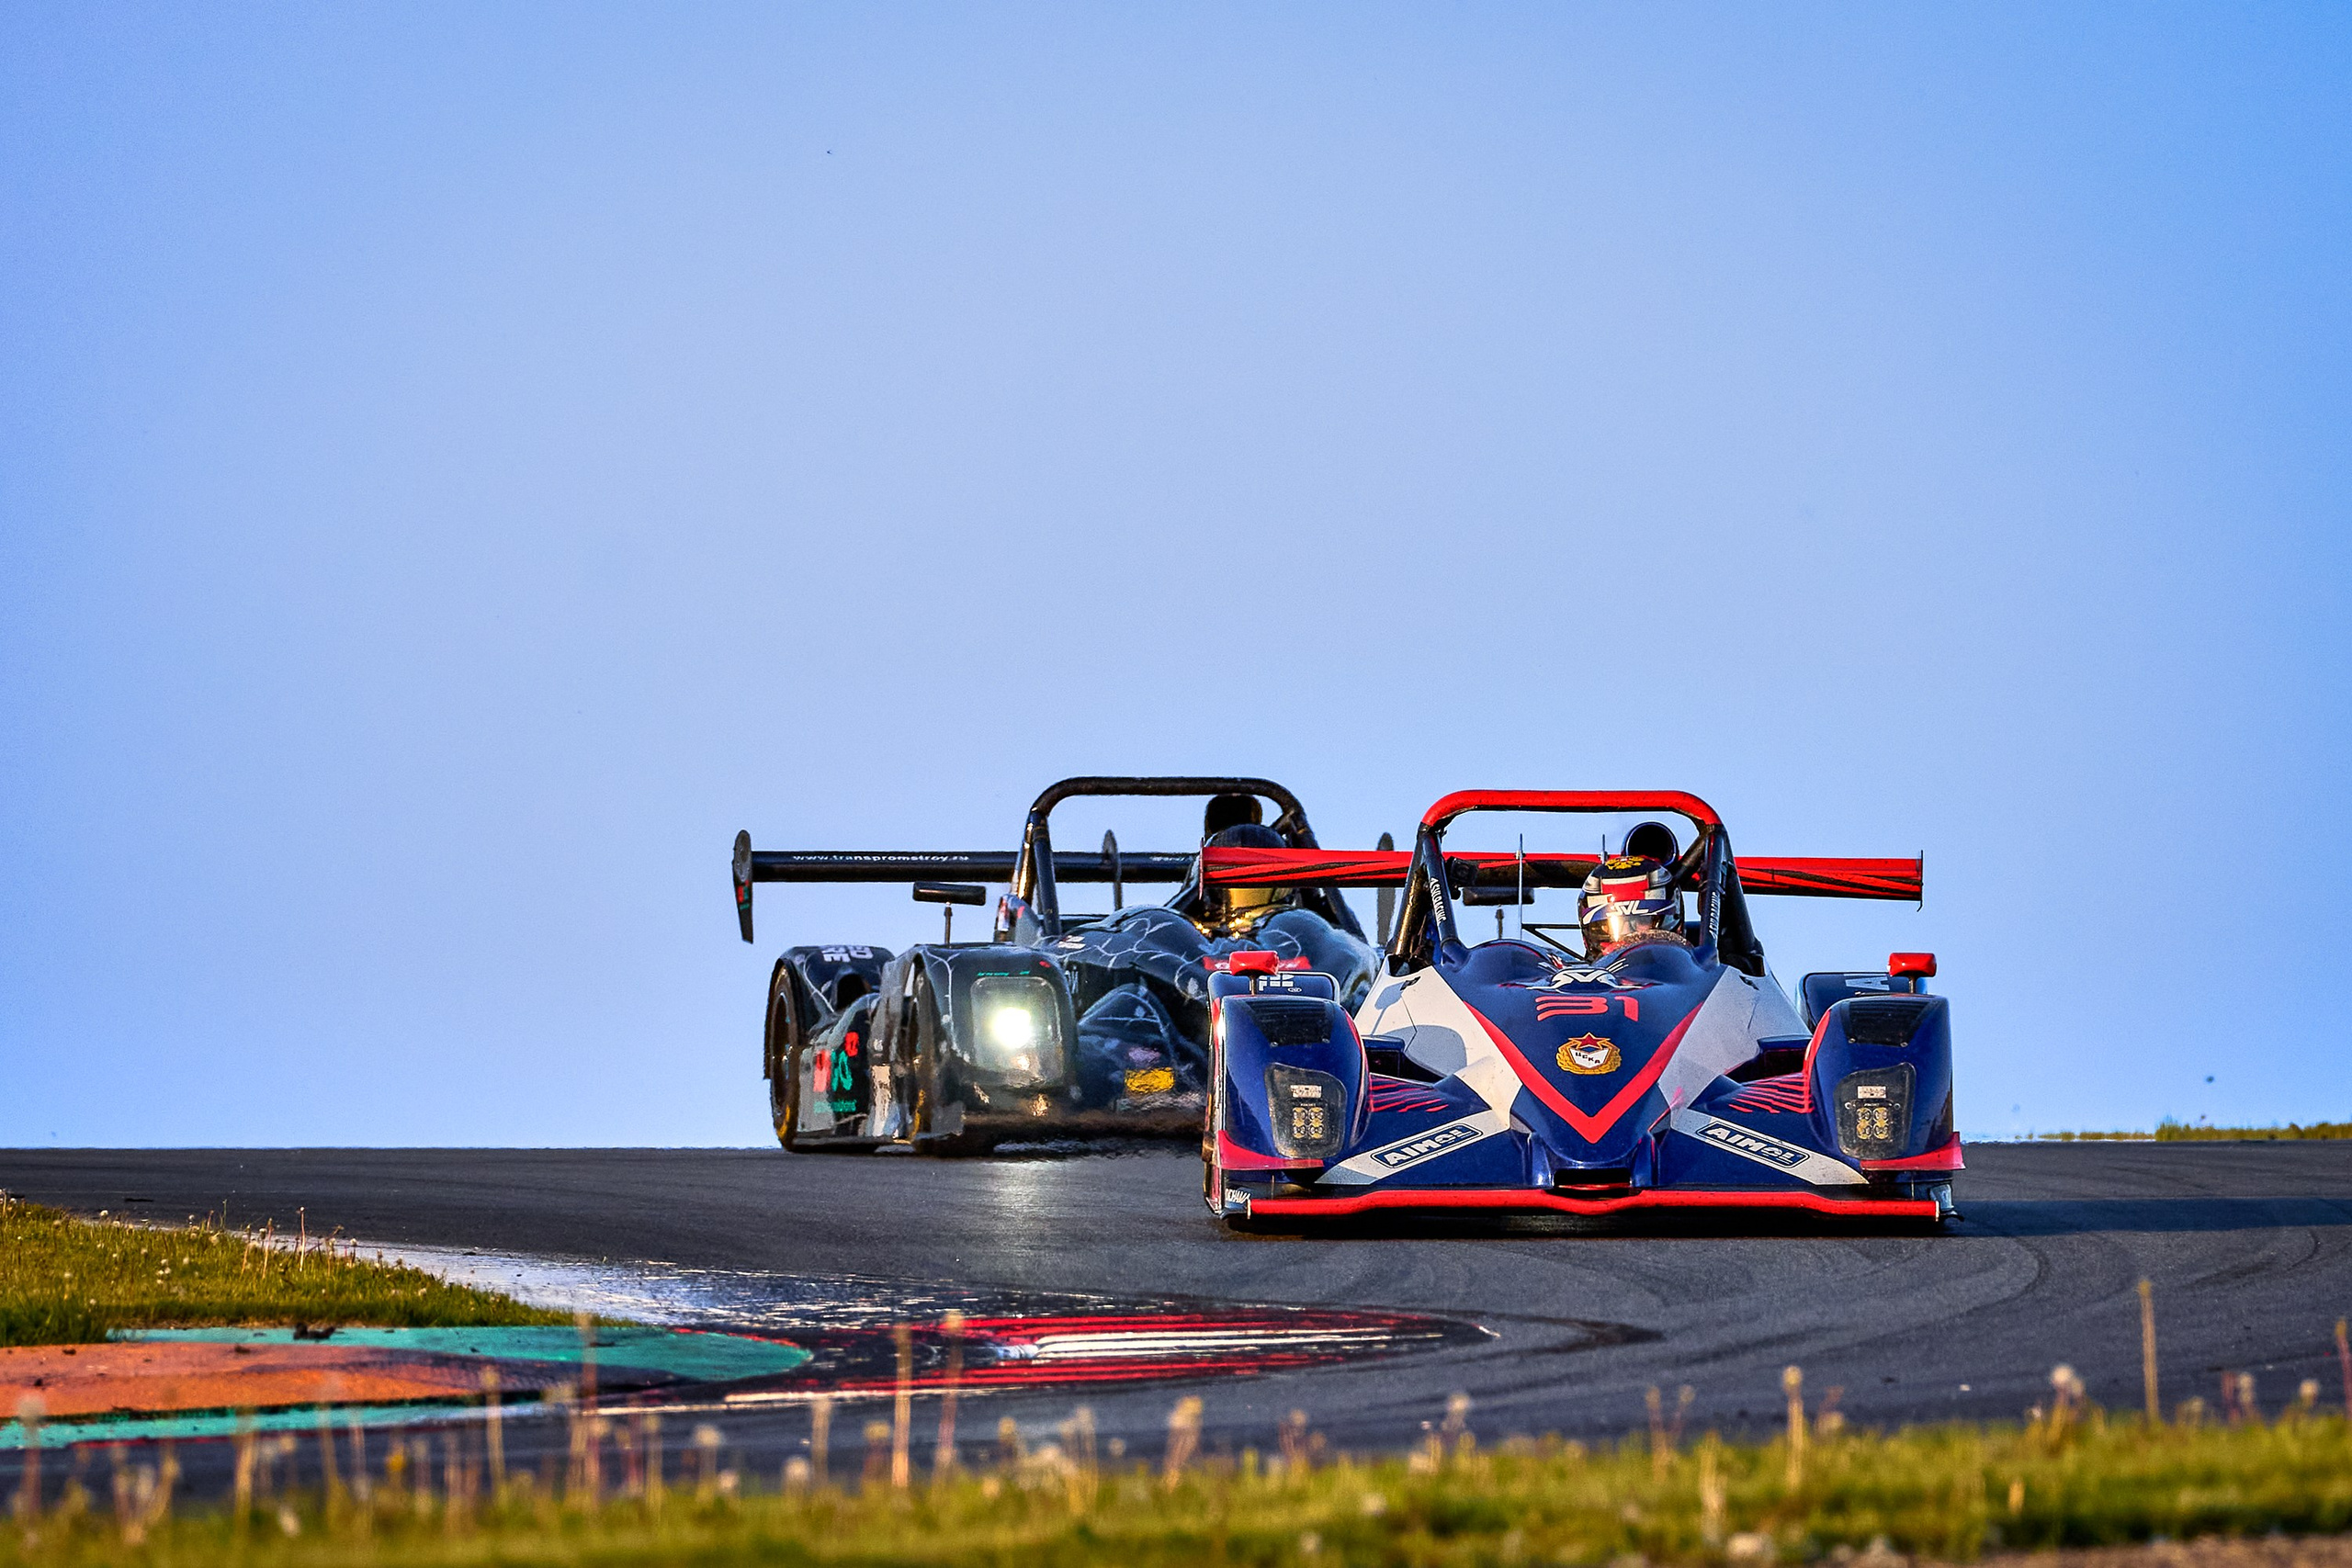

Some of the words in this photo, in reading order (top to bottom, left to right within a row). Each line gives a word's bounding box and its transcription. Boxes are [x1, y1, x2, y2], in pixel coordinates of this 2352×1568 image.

[1535, 996, 1639, 1021] 31
[1576, 1051, 1600, 1064] ЦСКА
[1384, 1129, 1472, 1166] AIMOL
[1705, 1126, 1795, 1164] AIMOL
